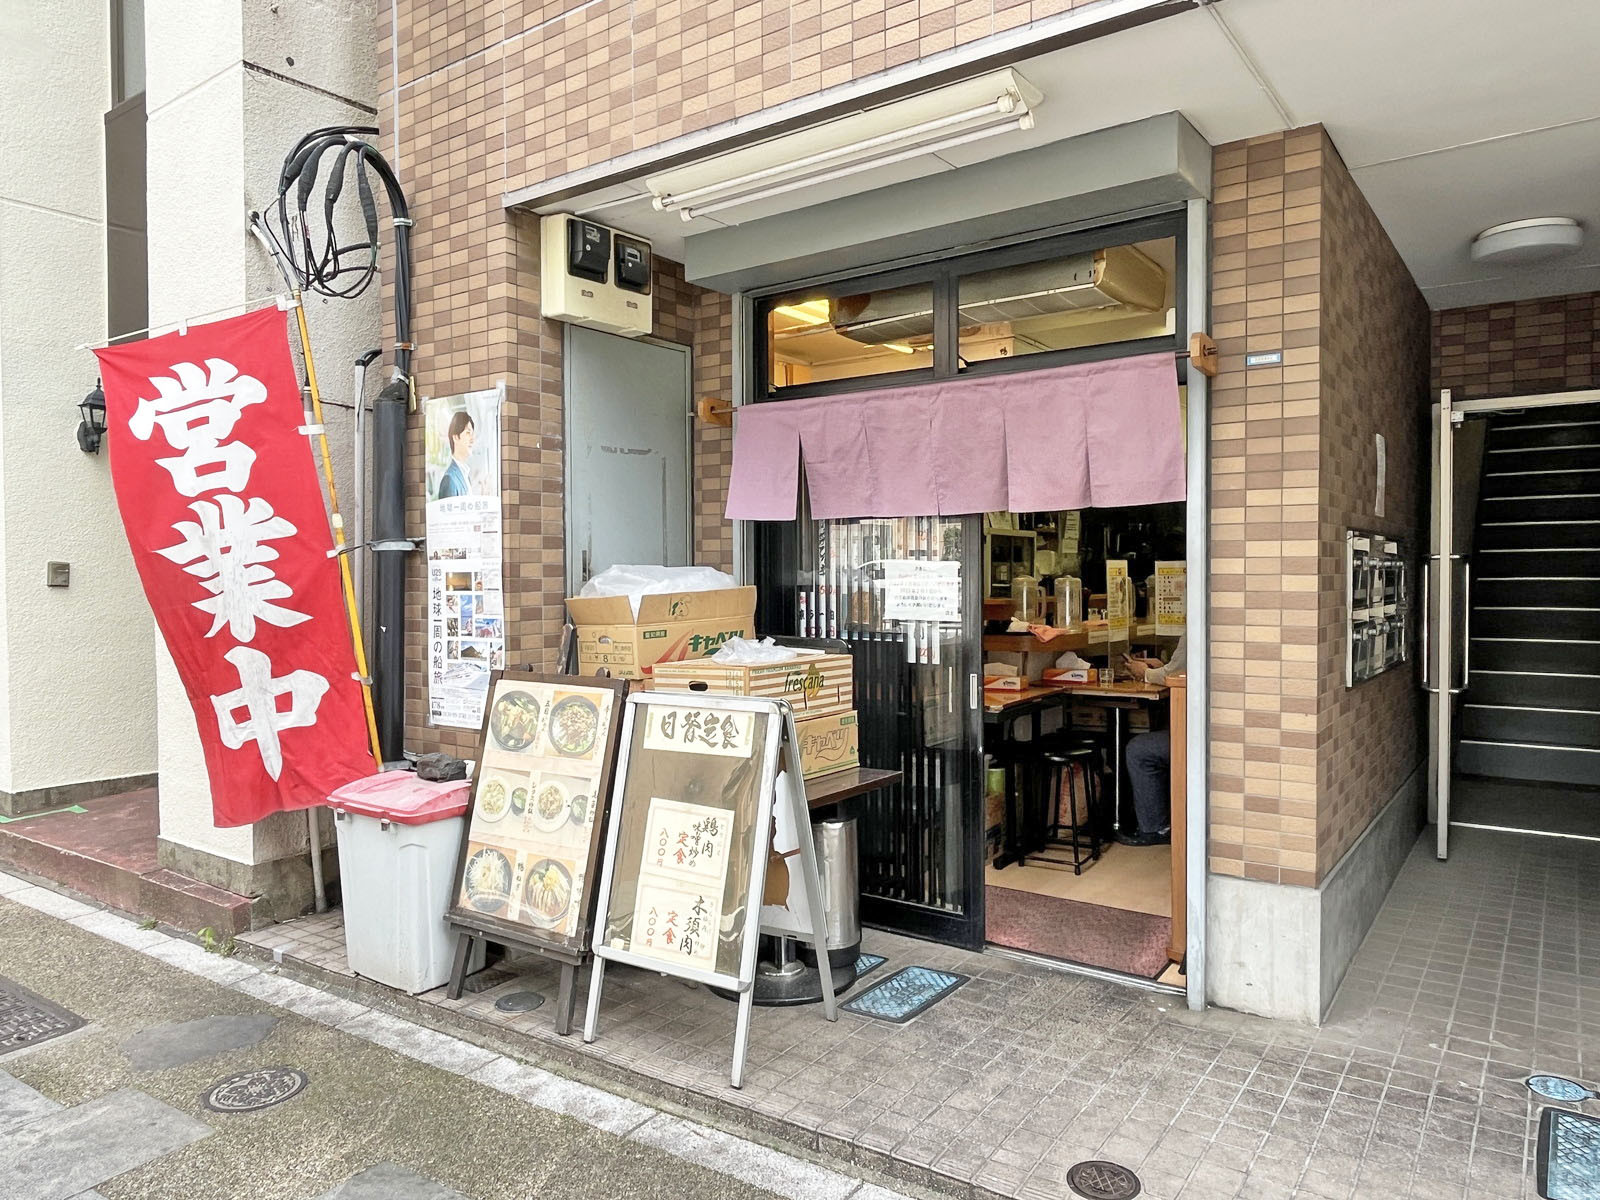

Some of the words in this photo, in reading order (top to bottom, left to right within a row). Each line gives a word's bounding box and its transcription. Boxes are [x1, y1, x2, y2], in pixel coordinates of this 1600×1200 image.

[128, 357, 331, 783] 営業中
[432, 586, 443, 685] 地球一周の船旅
[783, 670, 826, 693] frescana
[803, 726, 850, 759] キャベツ
[673, 831, 689, 865] 定食
[688, 821, 702, 868] 味噌炒め
[700, 816, 719, 859] 鶏肉
[662, 910, 679, 945] 定食
[679, 895, 708, 956] 木須肉
